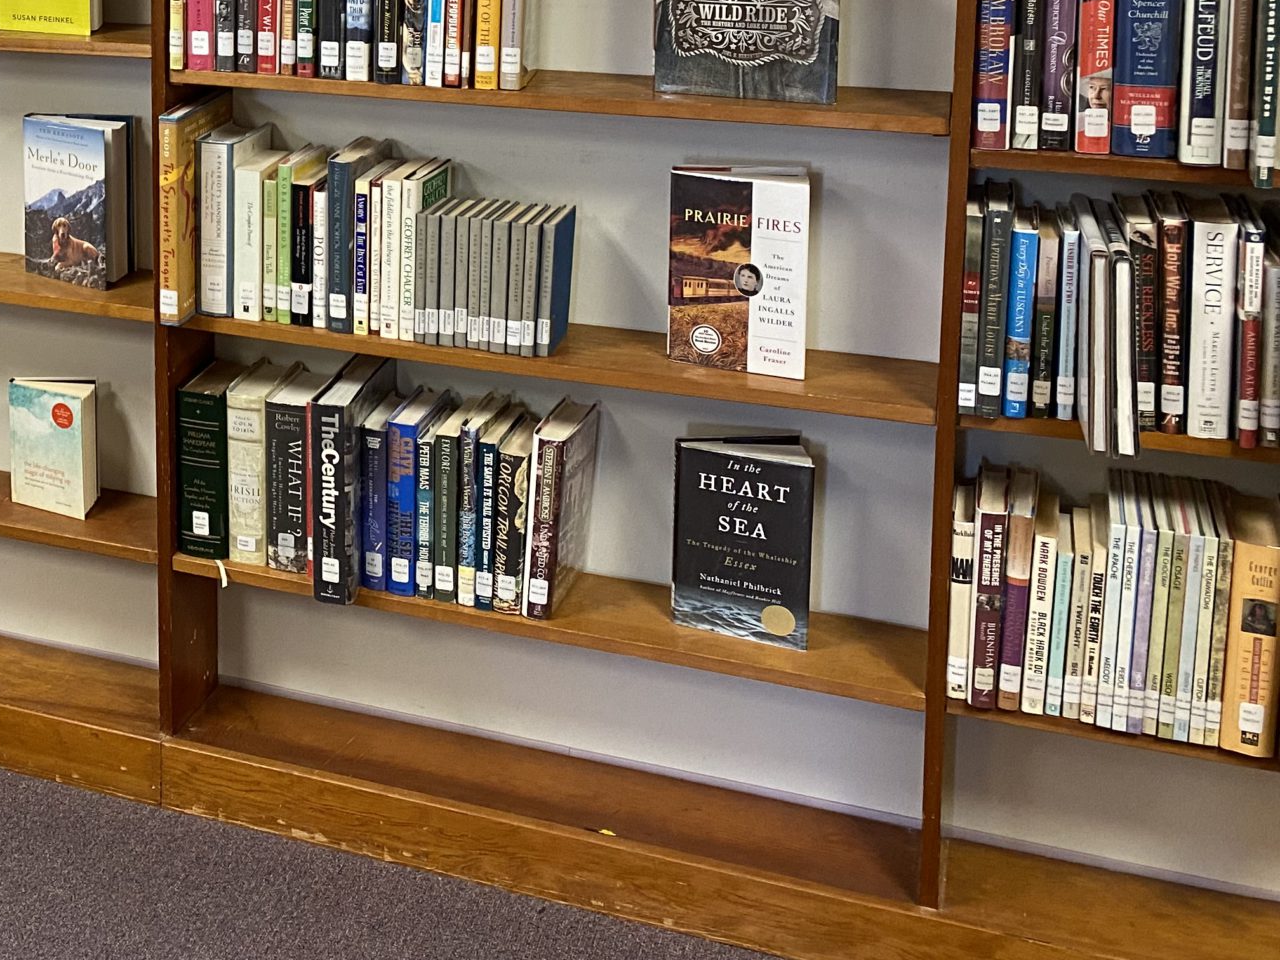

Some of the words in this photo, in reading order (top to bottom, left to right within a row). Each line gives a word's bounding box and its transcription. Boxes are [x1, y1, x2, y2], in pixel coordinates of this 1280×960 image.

[11, 13, 37, 22] SUSAN
[38, 14, 74, 24] FREINKEL
[698, 3, 743, 21] WILD
[744, 5, 788, 23] RIDE
[1099, 0, 1111, 22] Our
[1127, 9, 1170, 20] Churchill
[988, 14, 1006, 86] BROKAW
[1095, 25, 1110, 68] TIMES
[1196, 15, 1216, 62] FEUD
[1263, 46, 1277, 83] Irish
[1262, 90, 1273, 118] Eyes
[162, 128, 171, 158] WOOD
[27, 146, 65, 167] Merle's
[67, 152, 98, 173] Door
[163, 162, 174, 182] The
[162, 185, 176, 242] Serpent's
[684, 208, 749, 228] PRAIRIE
[756, 217, 802, 234] FIRES
[312, 235, 324, 267] POE
[403, 216, 414, 261] GEOFFREY
[162, 244, 174, 290] Tongue
[763, 263, 793, 272] American
[765, 273, 790, 282] Dreams
[1203, 230, 1225, 316] SERVICE
[402, 263, 413, 307] CHAUCER
[757, 305, 796, 317] INGALLS
[762, 294, 792, 305] LAURA
[758, 316, 794, 328] WILDER
[759, 345, 792, 356] Caroline
[762, 355, 787, 365] Fraser
[275, 413, 300, 423] Robert
[275, 422, 301, 433] Cowley
[287, 440, 302, 501] WHAT
[319, 413, 340, 531] TheCentury
[727, 459, 740, 471] In
[744, 463, 762, 474] the
[229, 484, 261, 495] IRISH
[698, 472, 790, 504] HEART
[288, 505, 301, 524] IF
[727, 500, 738, 512] of
[741, 502, 759, 514] the
[718, 515, 767, 540] SEA
[723, 556, 758, 571] Essex
[1039, 541, 1050, 567] MARK
[699, 572, 741, 588] Nathaniel
[743, 580, 782, 596] Philbrick
[1037, 567, 1049, 603] BOWDEN
[1093, 571, 1105, 602] TOUCH
[1091, 603, 1102, 619] THE
[1088, 620, 1100, 645] EARTH
